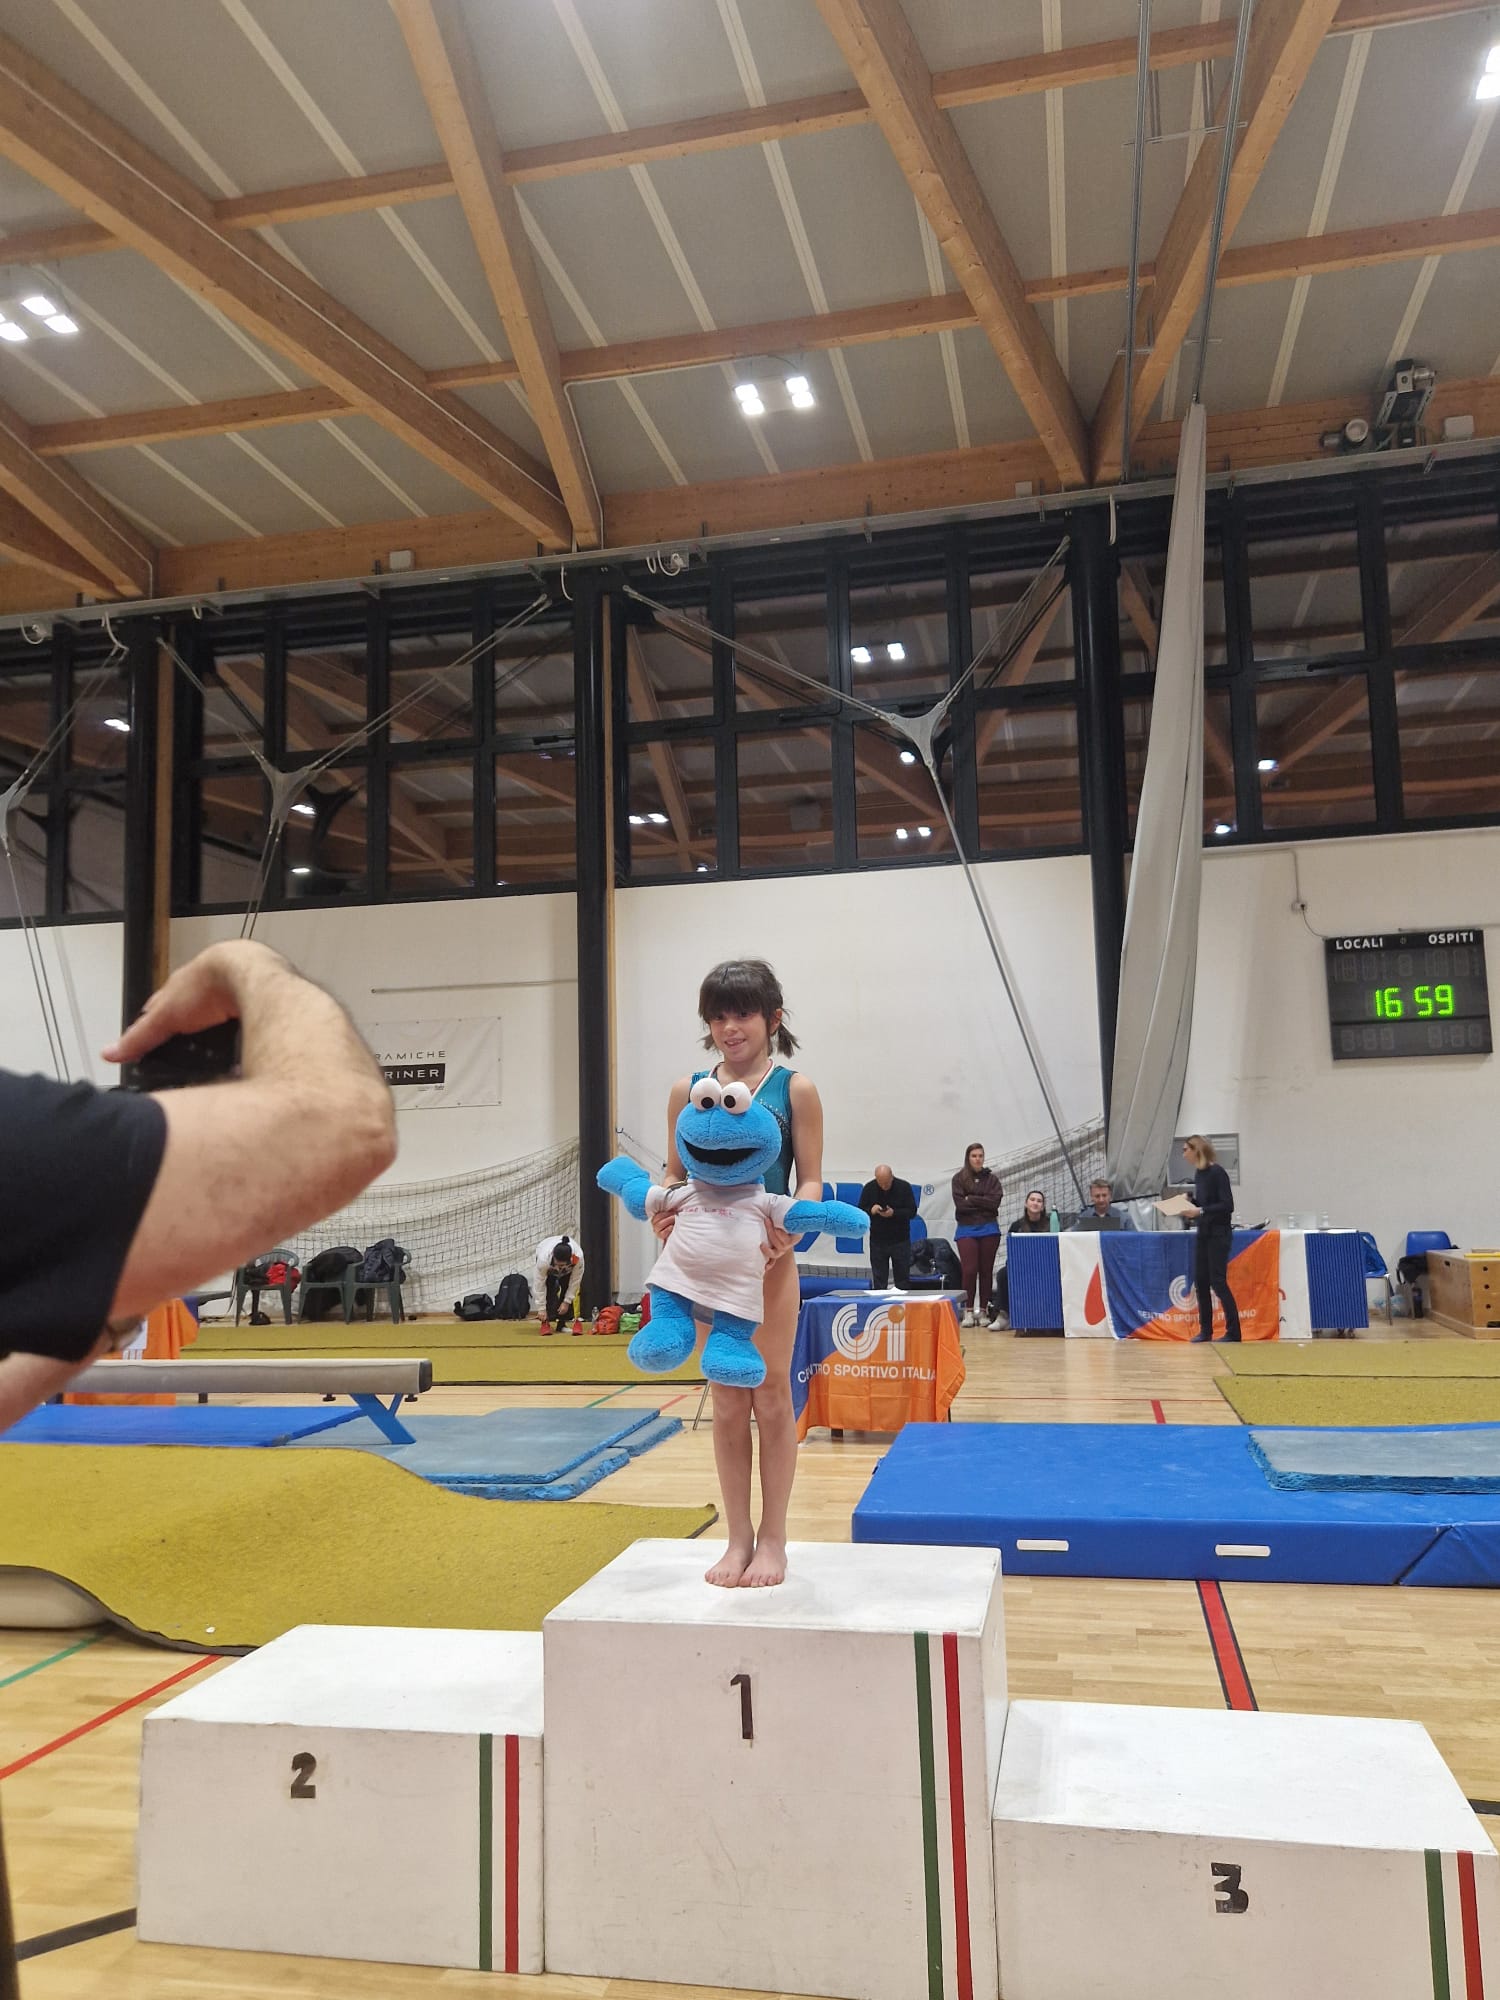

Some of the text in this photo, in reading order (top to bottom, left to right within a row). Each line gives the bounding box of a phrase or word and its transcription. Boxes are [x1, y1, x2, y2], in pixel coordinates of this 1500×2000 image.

[1335, 932, 1474, 950] LOCALI OSPITI
[1374, 985, 1454, 1017] 16 59
[384, 1069, 440, 1080] RINER
[1217, 1308, 1257, 1321] ITANO
[833, 1363, 899, 1380] SPORTIVO
[730, 1674, 754, 1740] 1
[290, 1752, 316, 1799] 2
[1211, 1862, 1249, 1914] 3
